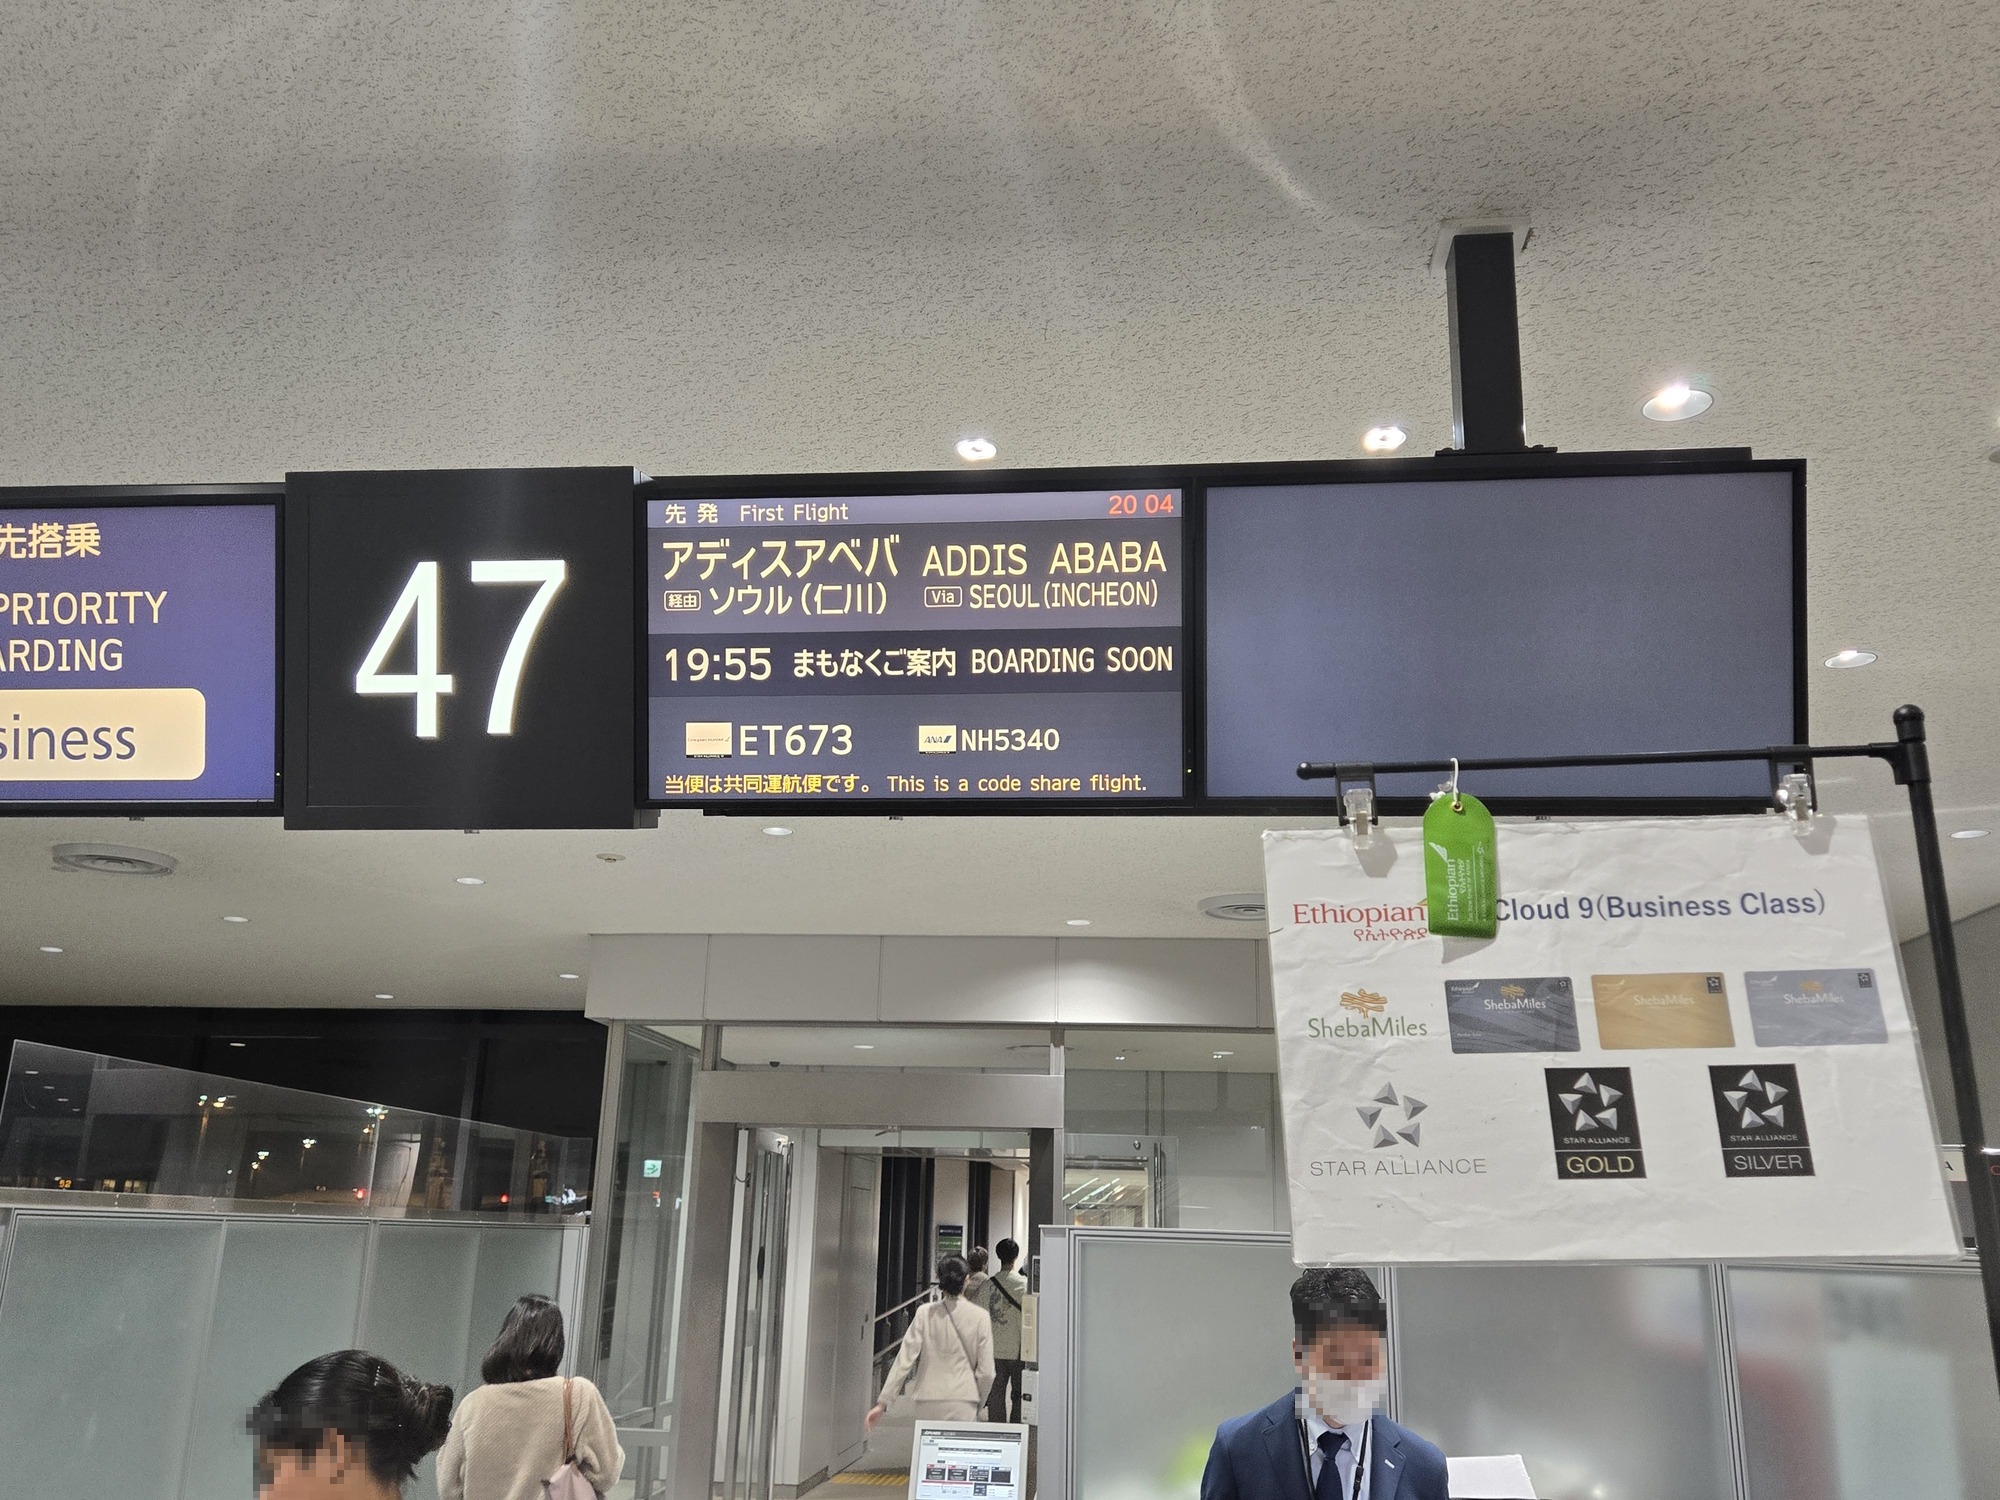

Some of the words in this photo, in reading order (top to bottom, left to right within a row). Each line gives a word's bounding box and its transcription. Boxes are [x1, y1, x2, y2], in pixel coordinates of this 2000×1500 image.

[740, 505, 784, 522] First
[793, 503, 849, 522] Flight
[1109, 495, 1137, 515] 20
[1145, 494, 1174, 514] 04
[662, 534, 900, 580] アディスアベバ
[922, 543, 1028, 577] ADDIS
[1049, 541, 1167, 574] ABABA
[668, 593, 698, 608] 経由
[931, 590, 955, 604] Via
[0, 638, 123, 671] RDING
[355, 559, 567, 738] 47
[665, 647, 772, 682] 19:55
[793, 648, 957, 678] まもなくご案内
[971, 647, 1095, 674] BOARDING
[1106, 646, 1173, 672] SOON
[740, 724, 853, 756] ET673
[924, 736, 943, 744] ANA
[961, 729, 1060, 751] NH5340
[665, 774, 870, 794] 当便は共同運航便です。
[887, 775, 925, 792] This
[934, 775, 949, 792] is
[958, 778, 969, 792] a
[978, 775, 1021, 792] code
[1030, 774, 1081, 791] share
[1089, 774, 1147, 793] flight.
[1446, 858, 1459, 921] Ethiopian
[1496, 897, 1570, 921] Cloud
[1740, 888, 1825, 915] Class)
[1293, 903, 1426, 928] Ethiopian
[1483, 997, 1547, 1011] ShebaMiles
[1633, 994, 1696, 1007] ShebaMiles
[1783, 992, 1845, 1006] ShebaMiles
[1307, 1016, 1428, 1039] ShebaMiles
[1563, 1137, 1587, 1145] STAR
[1588, 1136, 1631, 1144] ALLIANCE
[1730, 1134, 1752, 1142] STAR
[1755, 1133, 1799, 1142] ALLIANCE
[1310, 1160, 1366, 1177] STAR
[1375, 1158, 1487, 1176] ALLIANCE
[1566, 1156, 1635, 1174] GOLD
[1734, 1154, 1804, 1171] SILVER
